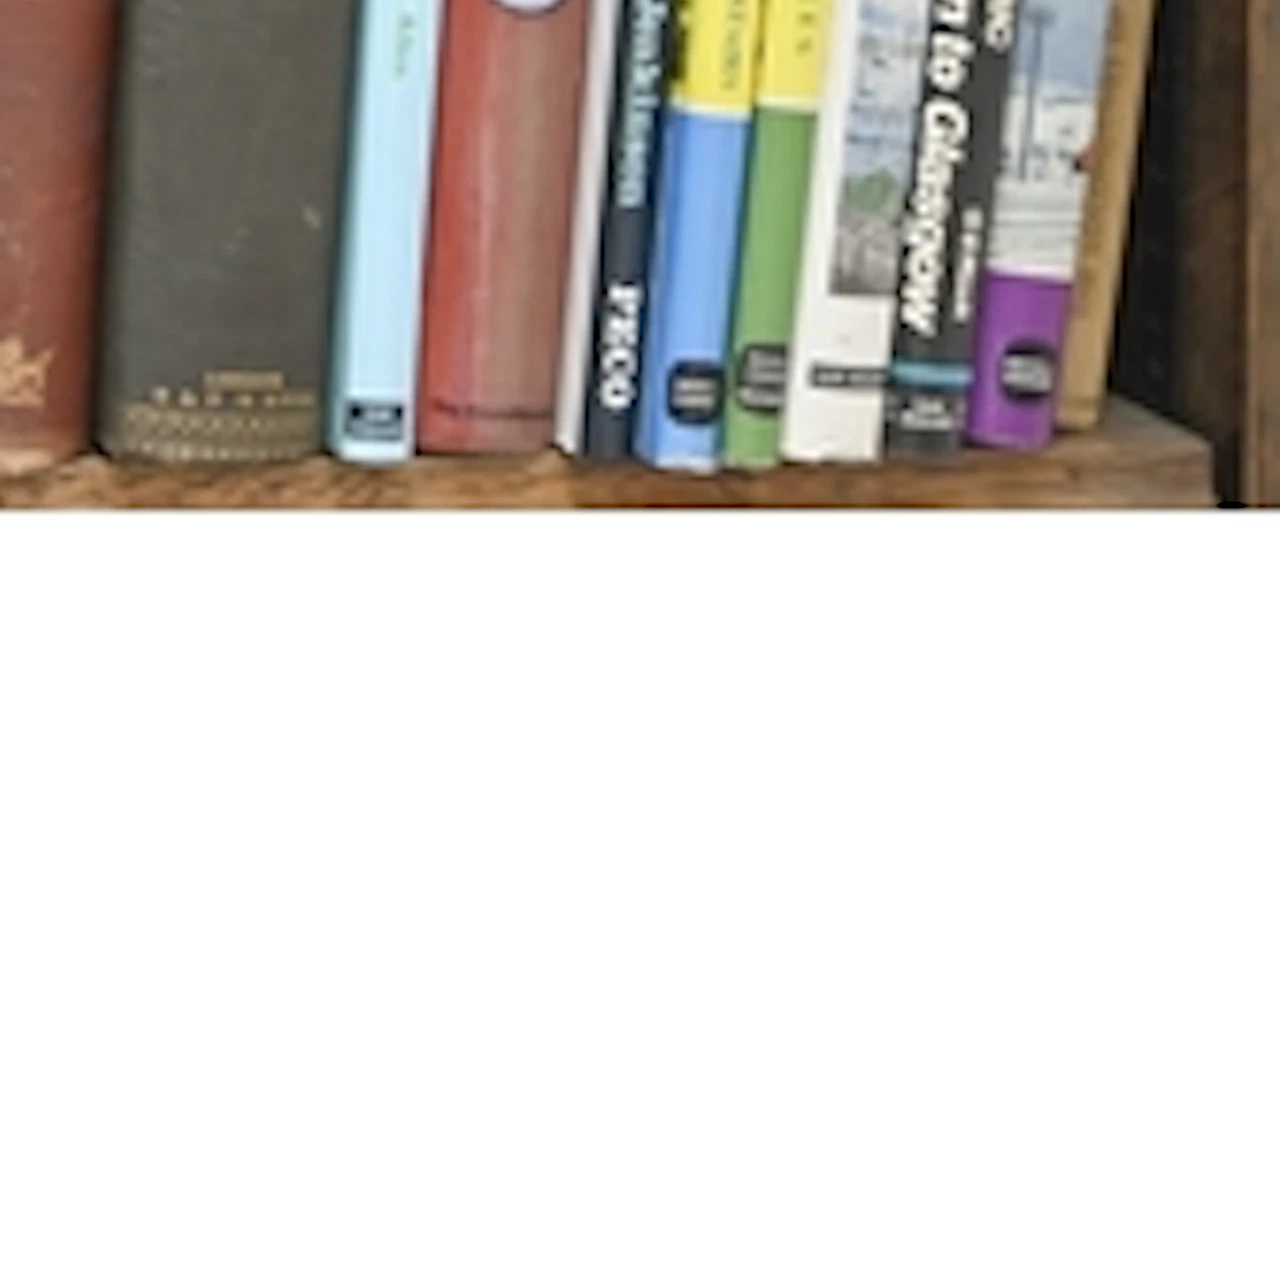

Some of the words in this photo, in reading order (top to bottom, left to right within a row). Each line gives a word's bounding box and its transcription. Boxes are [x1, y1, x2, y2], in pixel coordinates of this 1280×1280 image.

[930, 30, 975, 92] to
[900, 98, 970, 340] Glasgow
[597, 282, 639, 412] PECO
